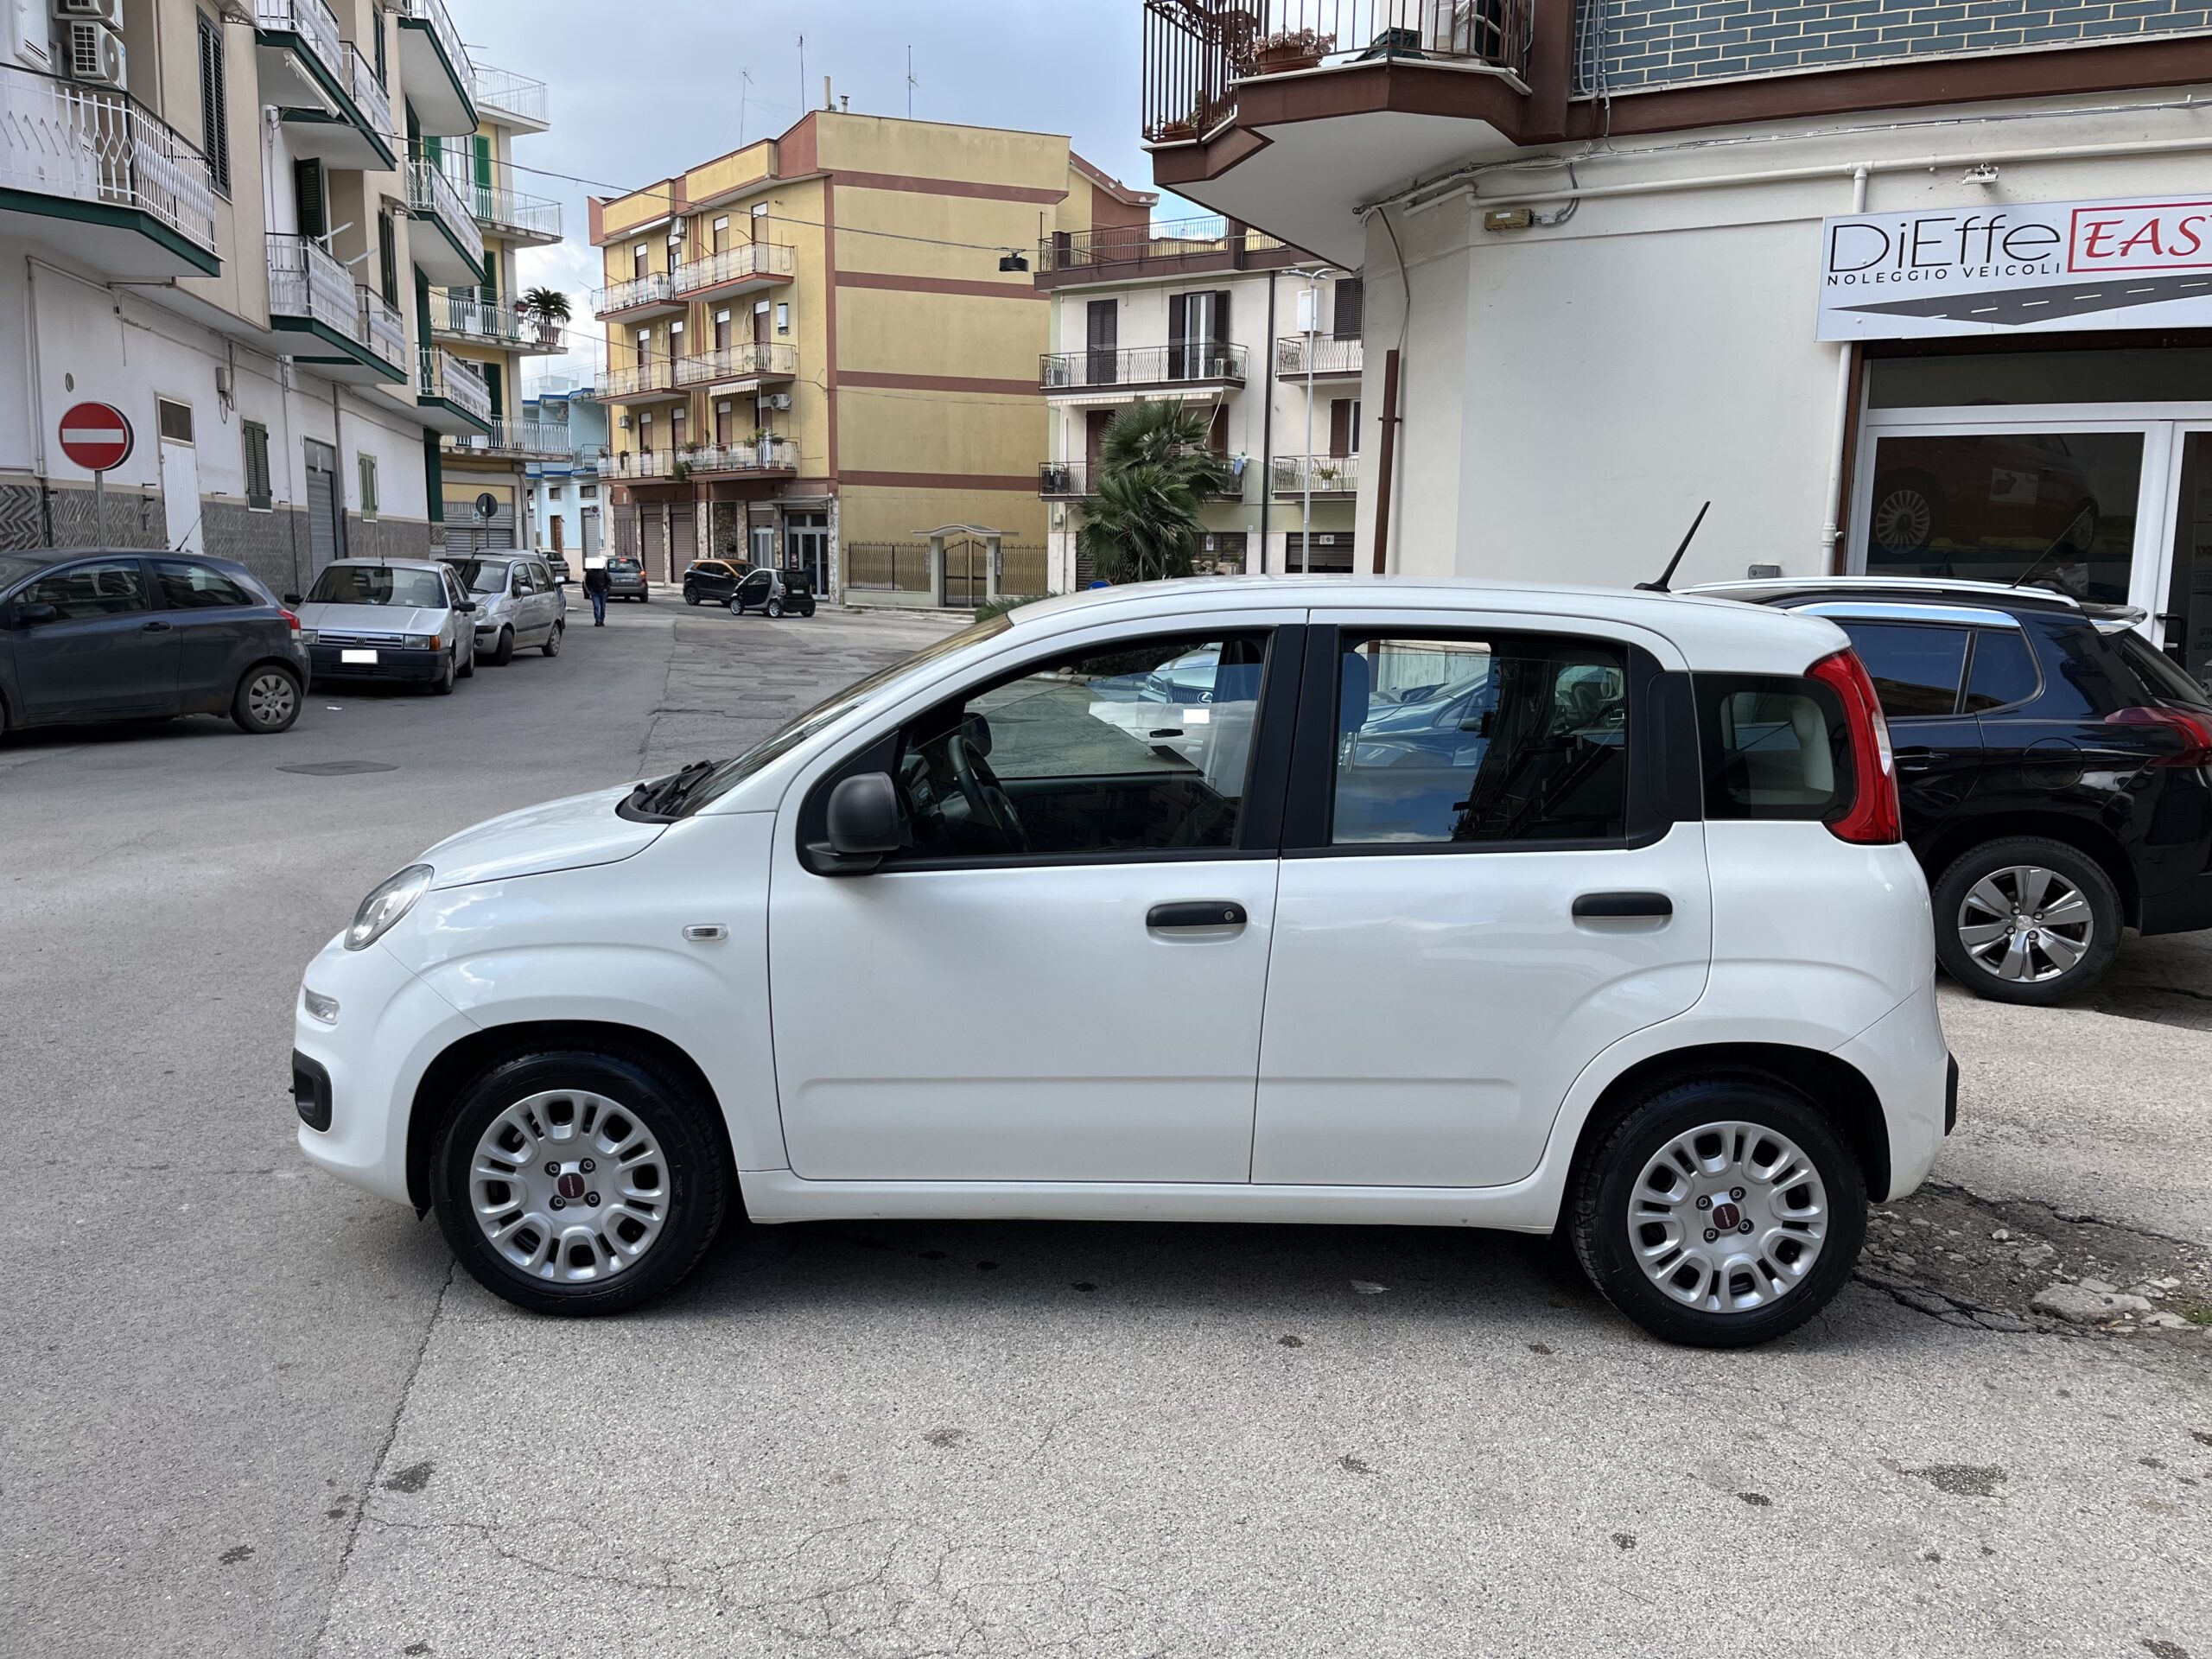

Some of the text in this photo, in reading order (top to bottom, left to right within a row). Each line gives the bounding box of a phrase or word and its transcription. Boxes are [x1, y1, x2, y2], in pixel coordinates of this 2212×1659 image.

[1829, 213, 2212, 273] DiEffe EAS
[1827, 262, 2061, 286] NOLEGGIO VEICOLI
